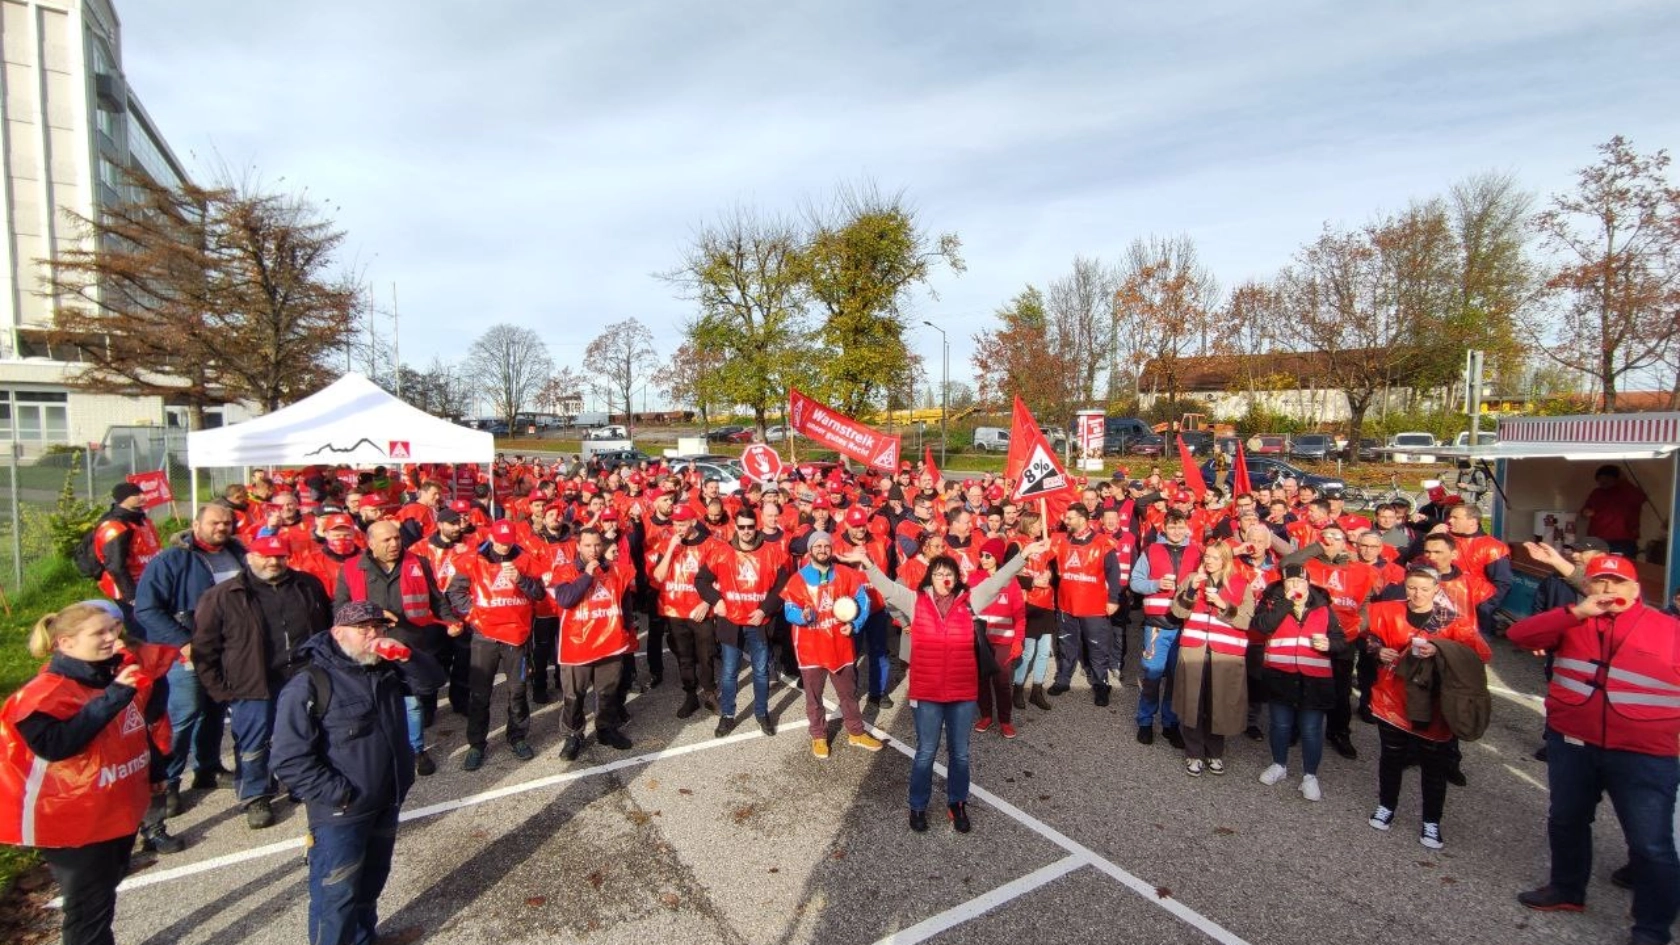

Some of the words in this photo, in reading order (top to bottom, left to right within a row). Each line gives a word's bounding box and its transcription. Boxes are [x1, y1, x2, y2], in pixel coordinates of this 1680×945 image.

[812, 408, 875, 449] Warnstreik
[1024, 458, 1050, 484] 8%
[1063, 571, 1097, 583] streiken
[726, 590, 768, 601] Warnstrei
